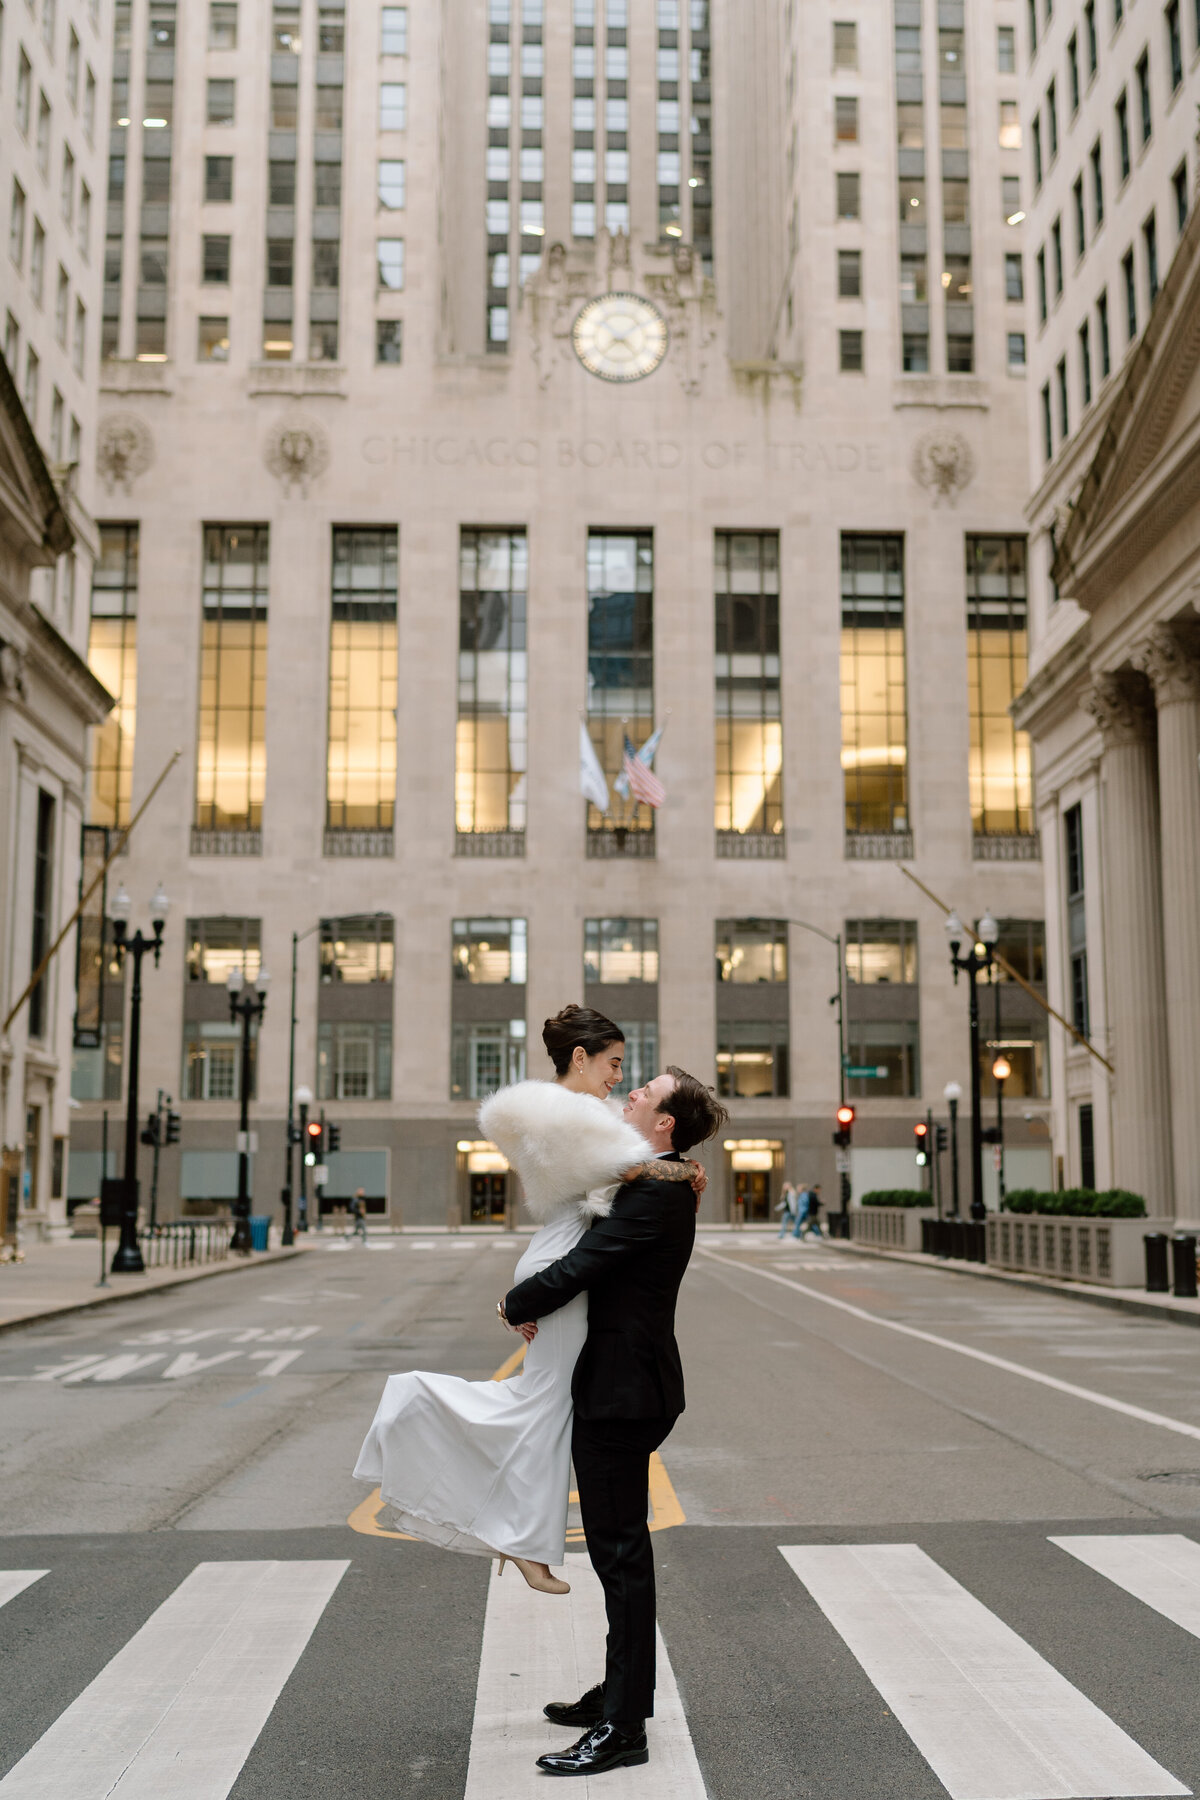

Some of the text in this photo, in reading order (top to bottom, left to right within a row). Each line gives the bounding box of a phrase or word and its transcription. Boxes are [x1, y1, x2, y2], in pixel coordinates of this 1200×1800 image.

[360, 434, 884, 472] CHICAGO BOARD OF TRADE
[32, 1349, 305, 1383] LANE
